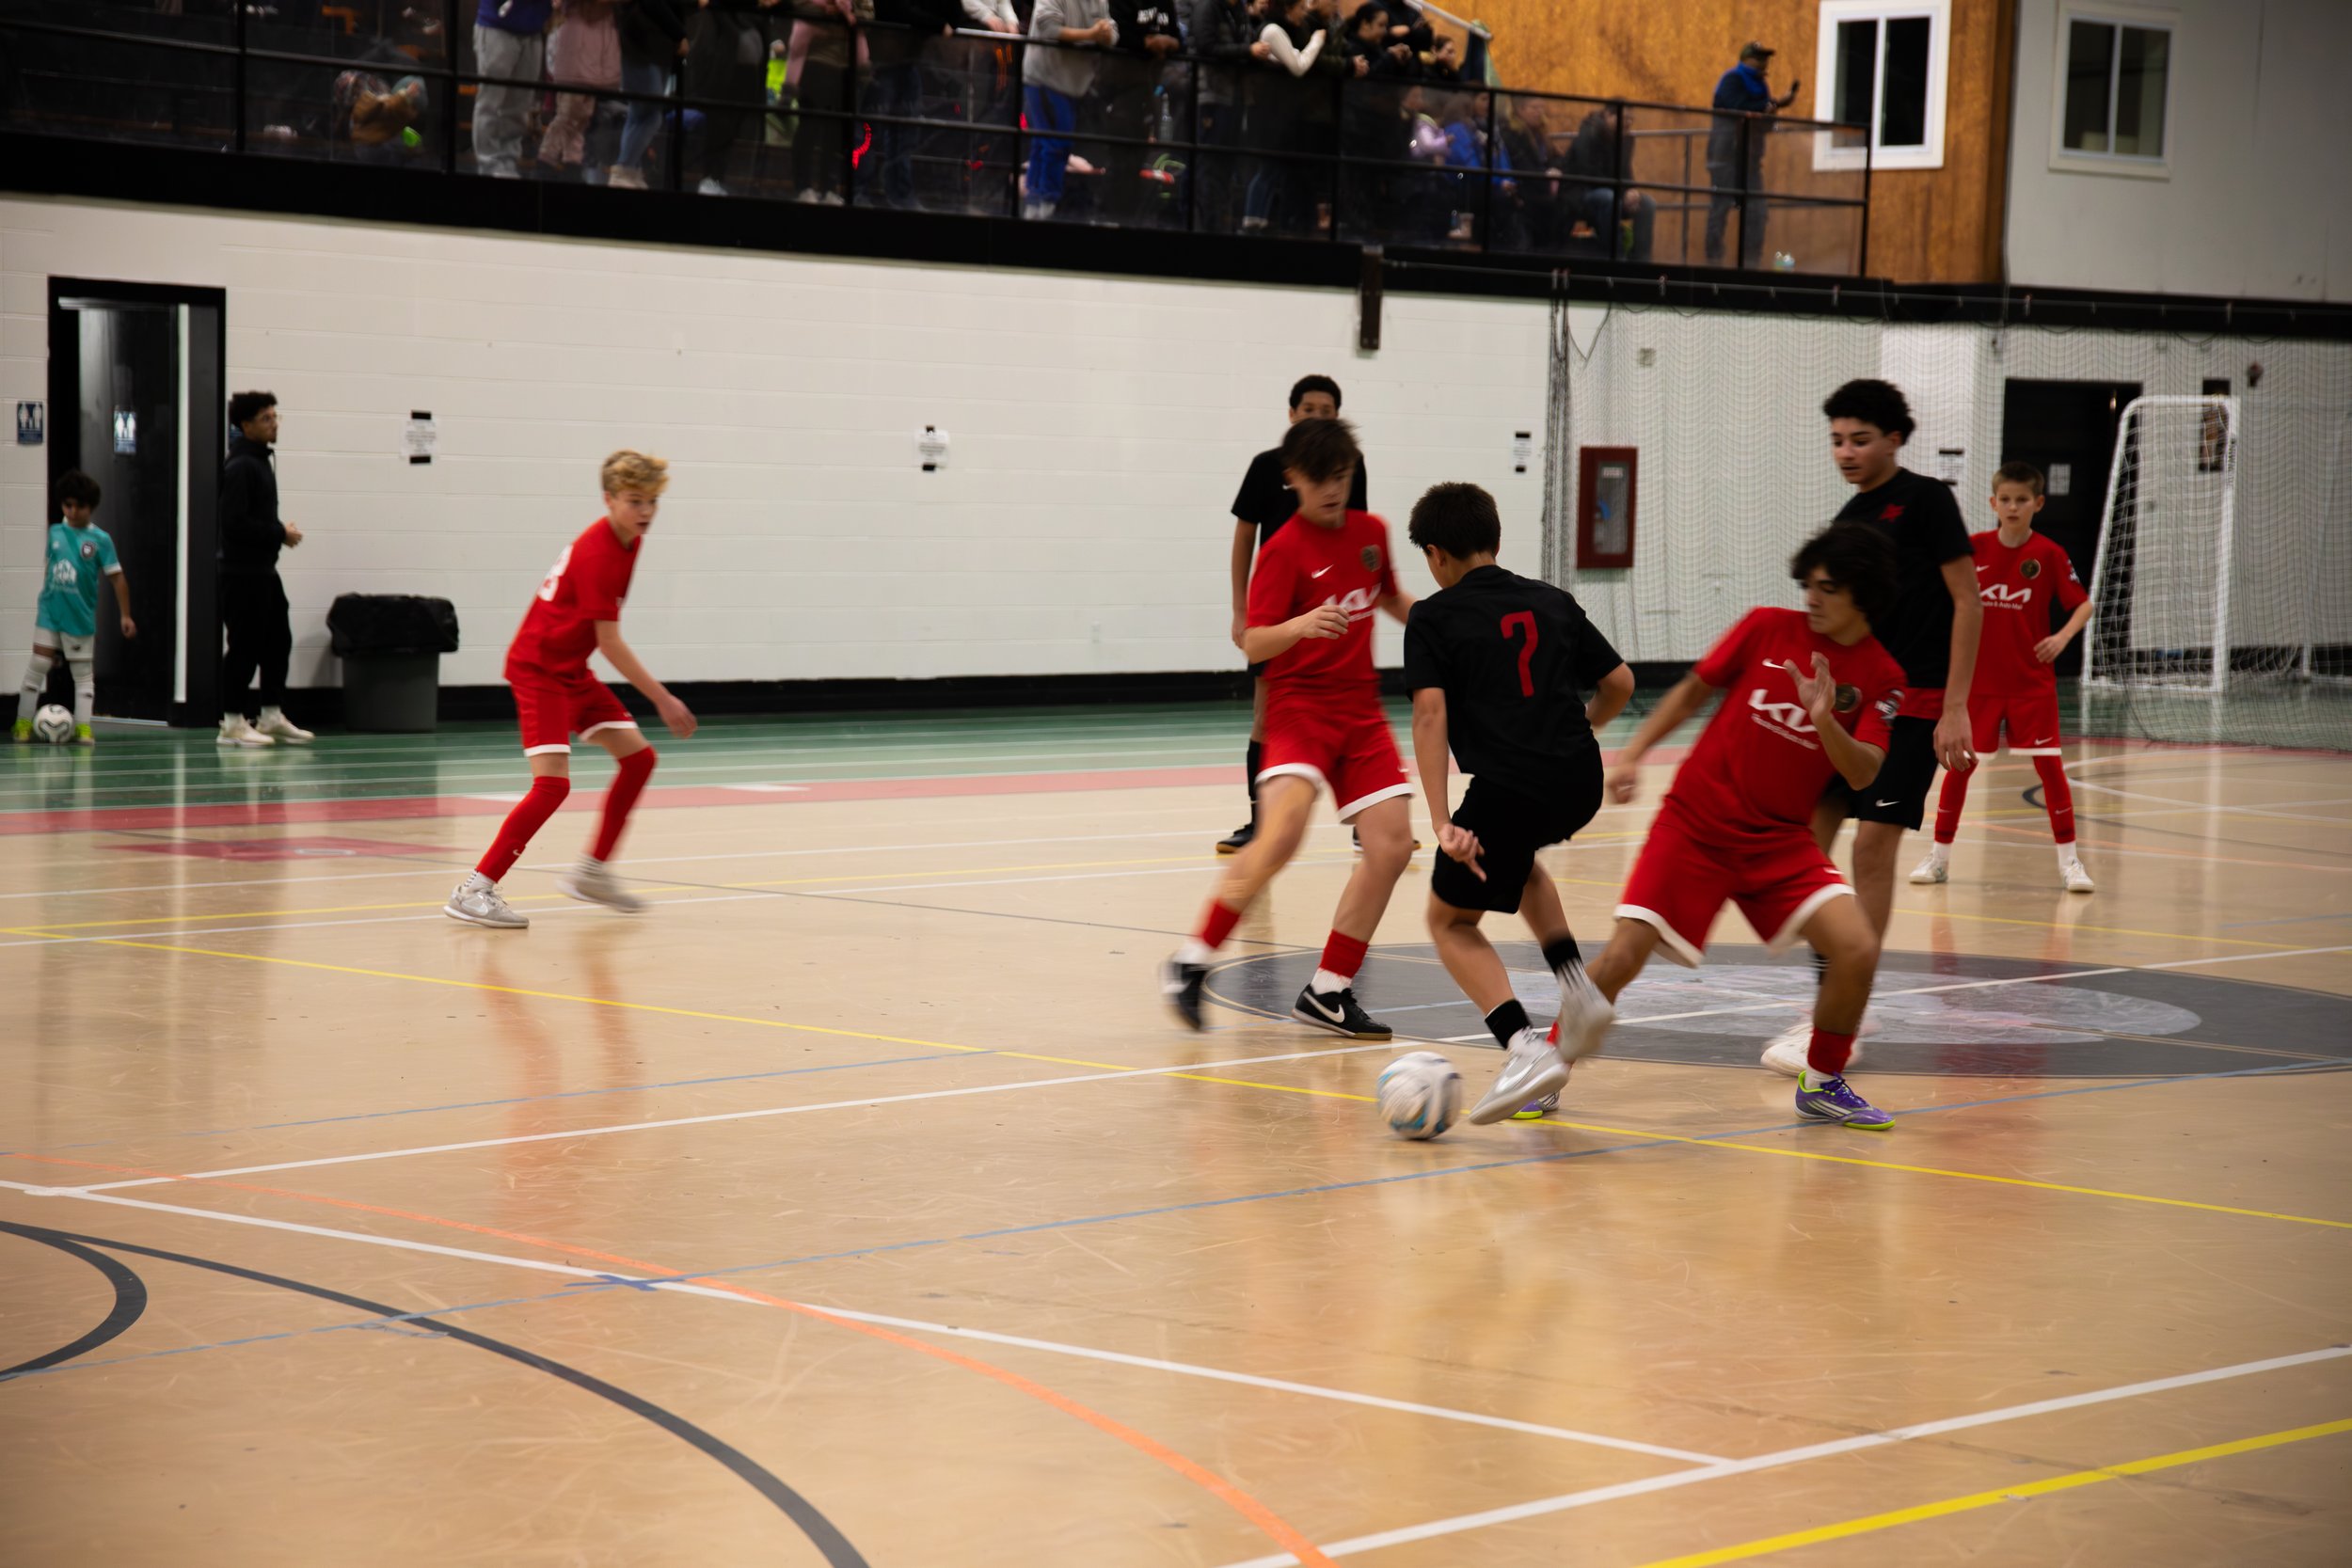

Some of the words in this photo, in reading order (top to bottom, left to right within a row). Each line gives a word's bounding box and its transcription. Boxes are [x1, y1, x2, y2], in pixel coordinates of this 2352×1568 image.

[1978, 583, 2032, 603] KIA
[1500, 610, 1539, 698] 7
[1747, 689, 1818, 733] KI
